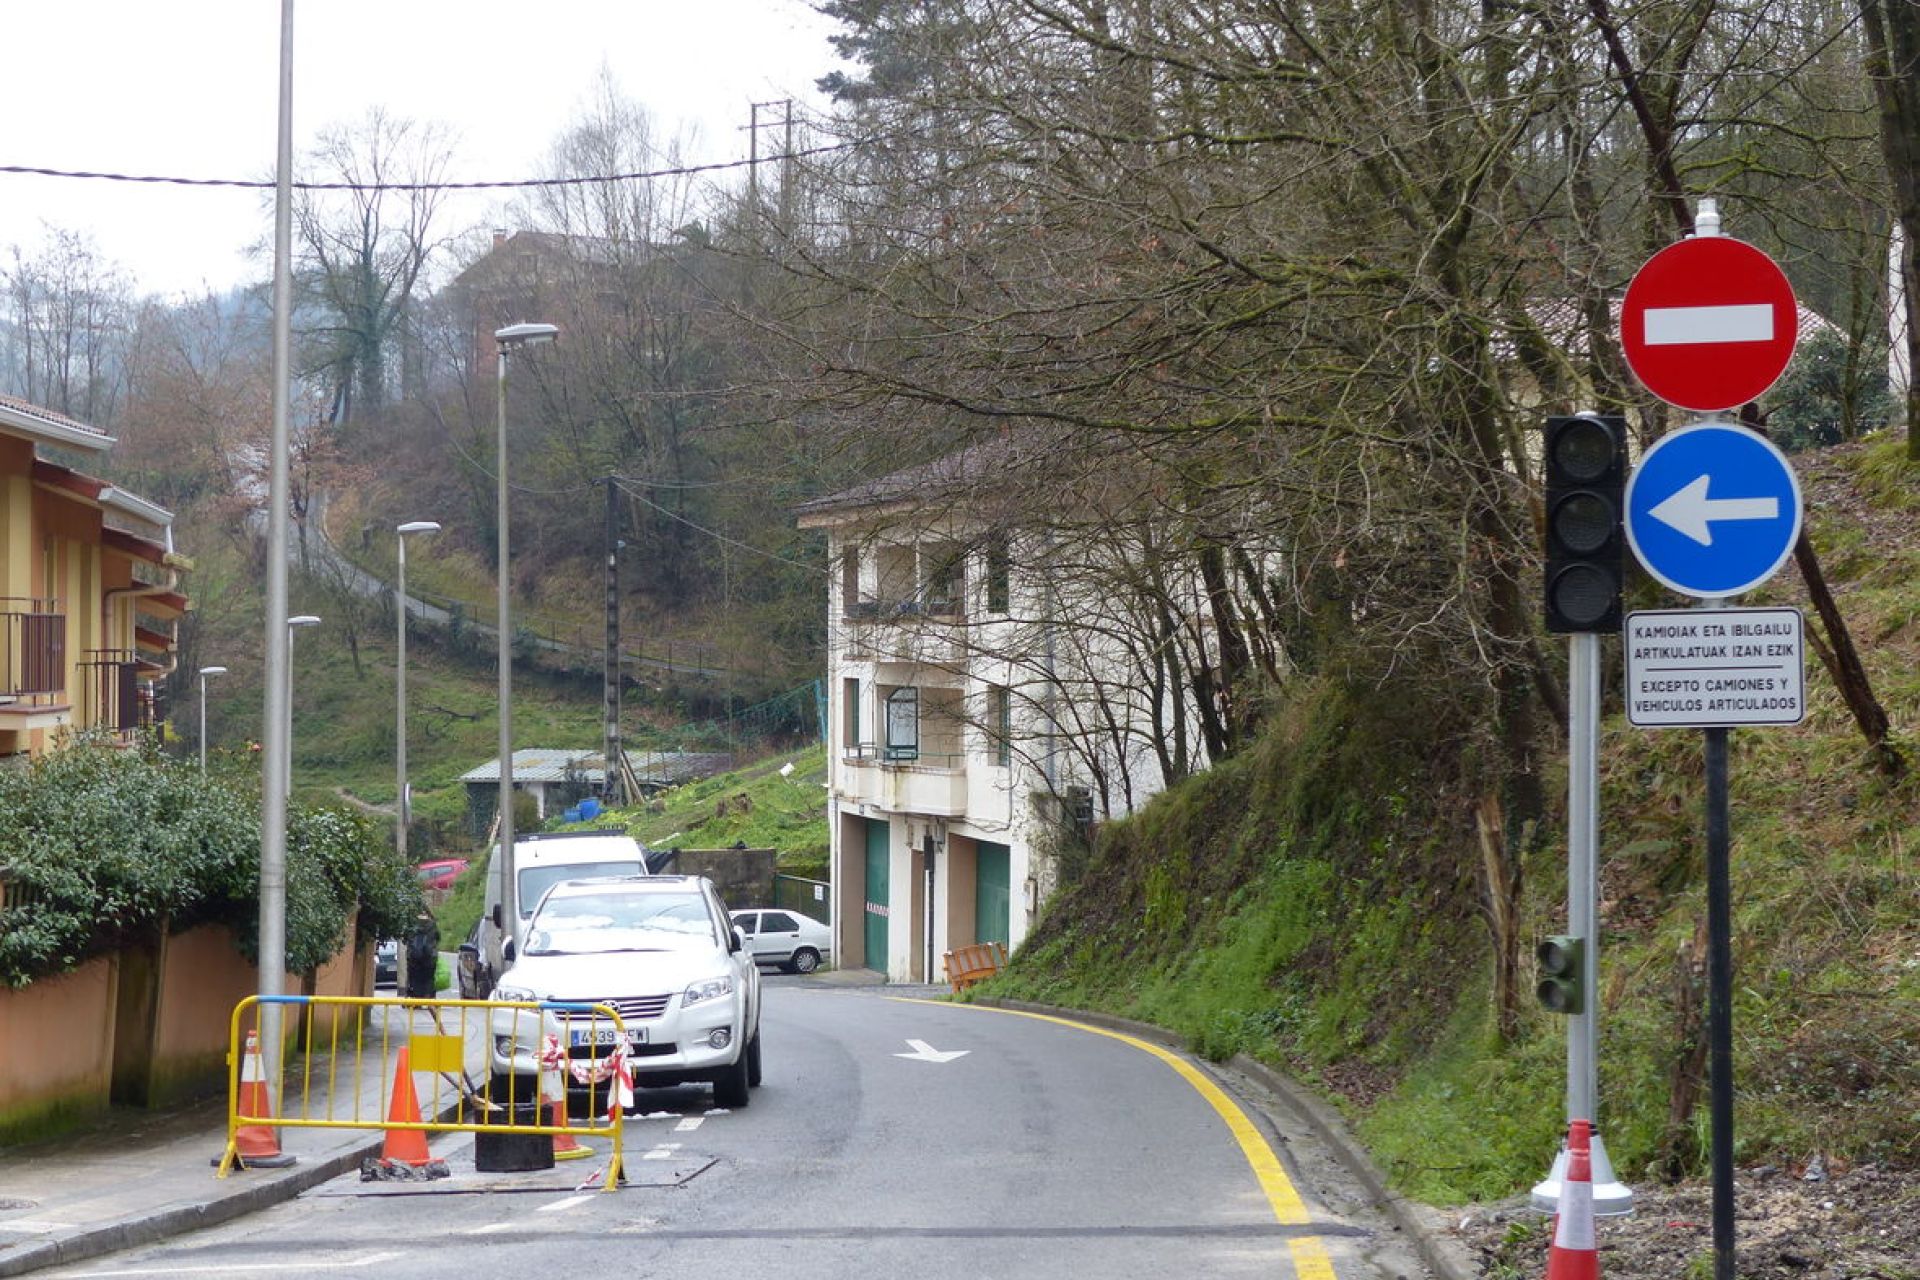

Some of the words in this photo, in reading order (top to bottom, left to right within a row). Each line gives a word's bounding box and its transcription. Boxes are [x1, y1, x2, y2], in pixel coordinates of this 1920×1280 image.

[1635, 625, 1697, 639] KAMIOIAK
[1703, 625, 1726, 637] ETA
[1731, 623, 1792, 637] IBILGAILU
[1634, 646, 1727, 659] ARTIKULATUAK
[1732, 645, 1762, 657] IZAN
[1767, 644, 1794, 656] EZIK
[1641, 679, 1700, 693] EXCEPTO
[1705, 679, 1774, 692] CAMIONES
[1780, 678, 1788, 690] Y
[1634, 700, 1702, 712] VEHICULOS
[1708, 697, 1796, 711] ARTICULADOS
